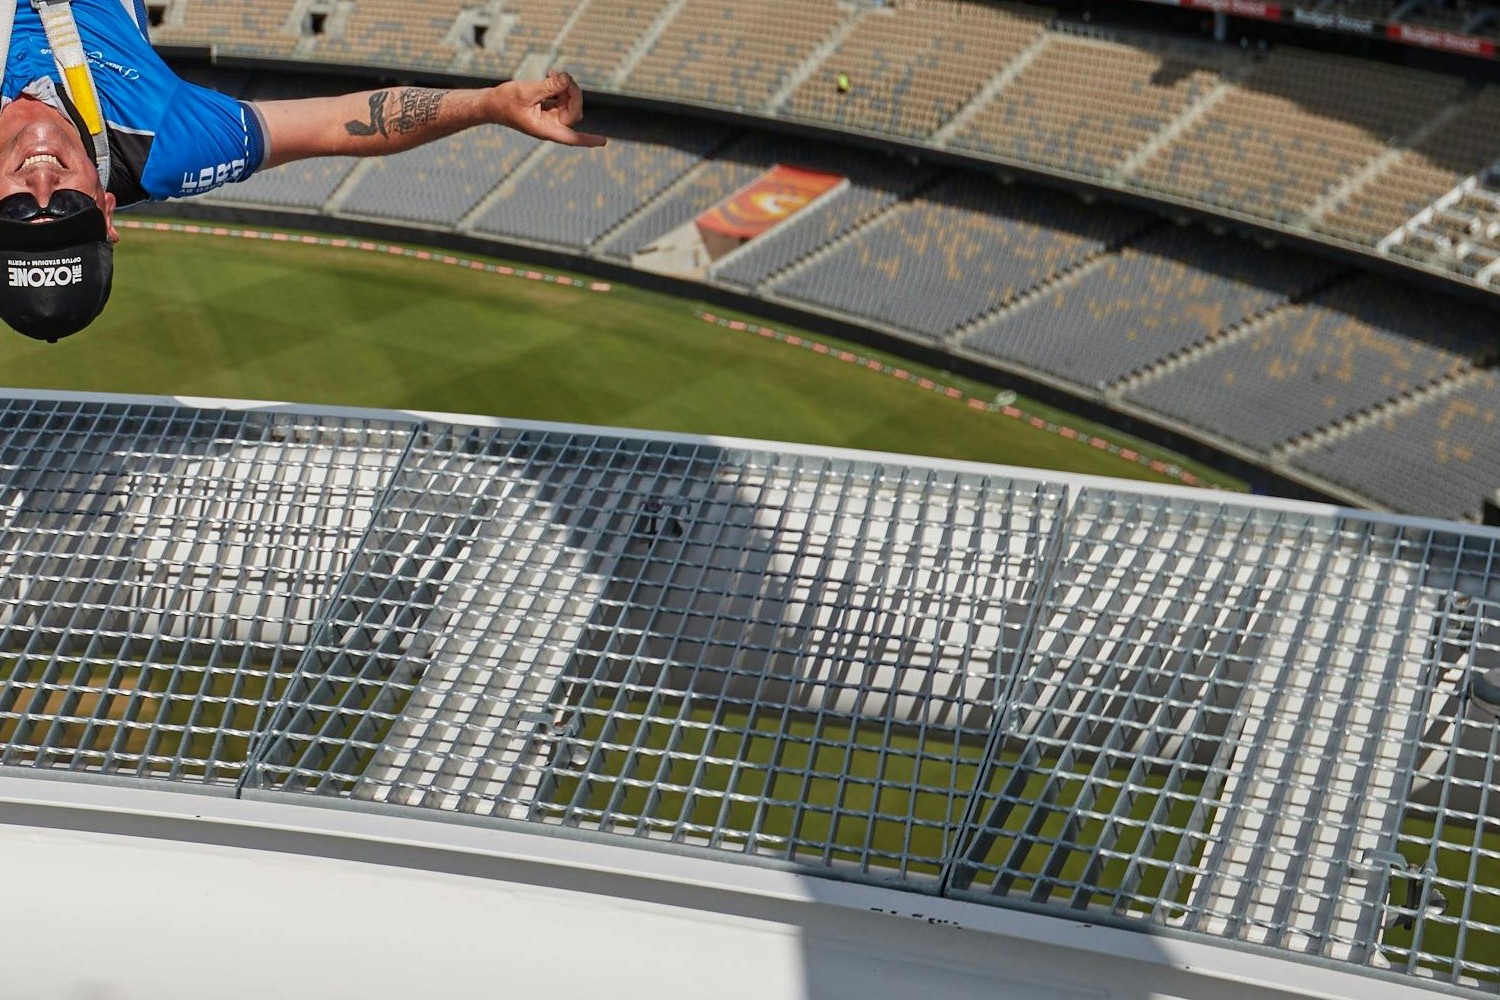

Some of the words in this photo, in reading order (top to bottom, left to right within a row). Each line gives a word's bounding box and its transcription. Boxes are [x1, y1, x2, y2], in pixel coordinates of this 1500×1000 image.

[61, 256, 82, 265] OPTUS
[7, 265, 73, 288] OZONE
[71, 264, 83, 285] THE
